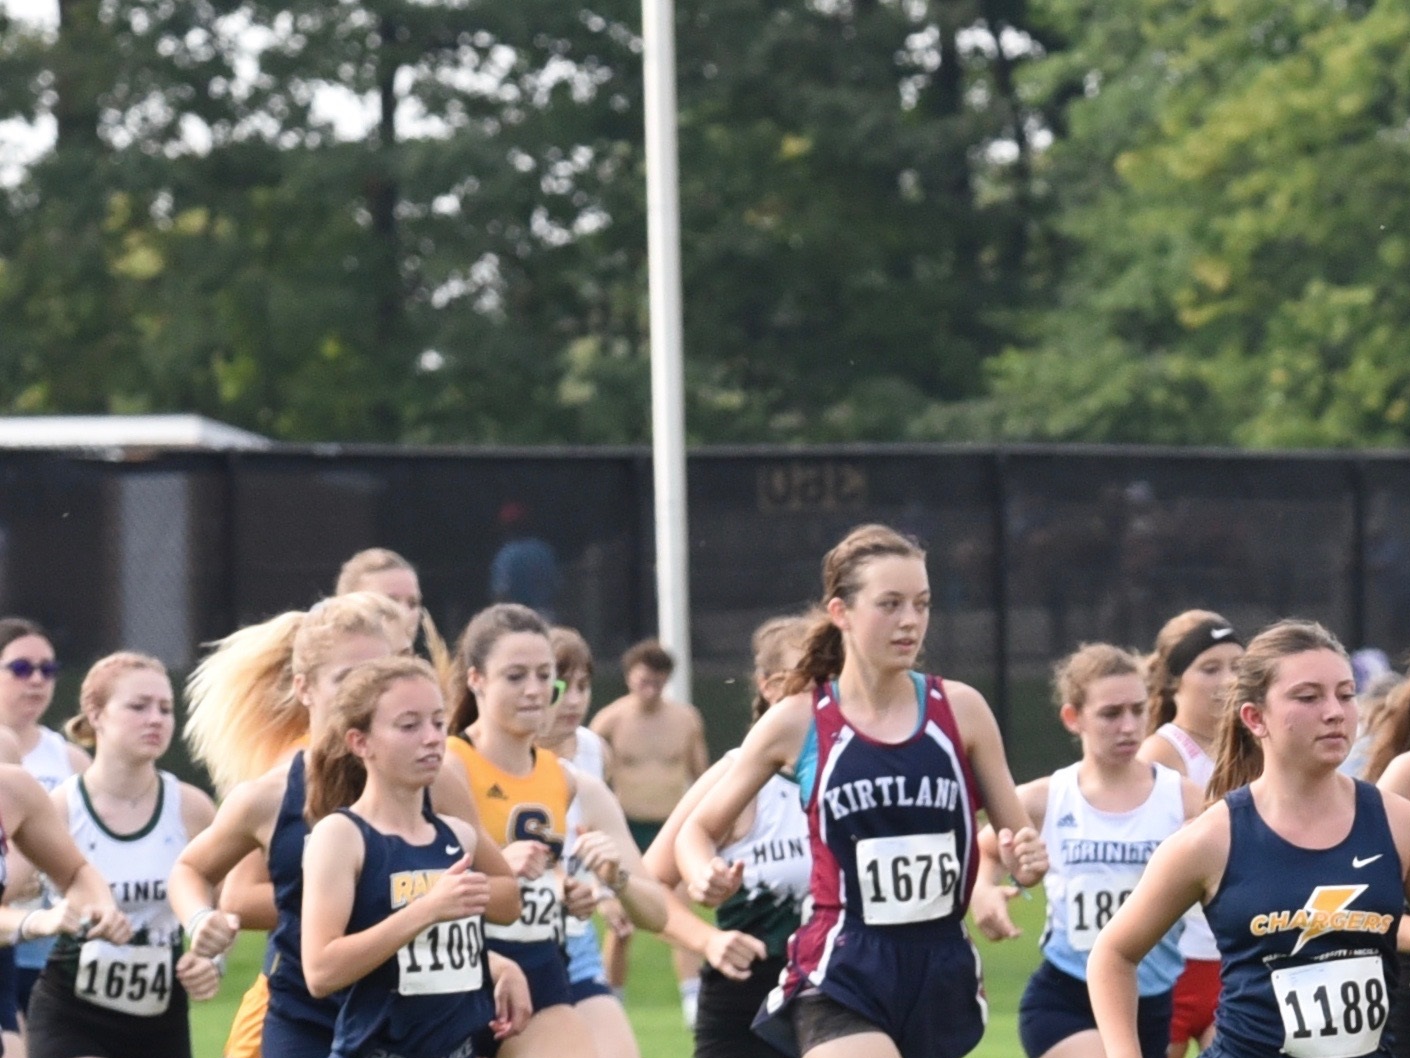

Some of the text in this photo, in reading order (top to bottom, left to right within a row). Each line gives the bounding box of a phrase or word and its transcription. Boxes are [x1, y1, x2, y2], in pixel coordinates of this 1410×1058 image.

[753, 838, 810, 864] HUN
[866, 853, 957, 903] 1676
[1250, 910, 1394, 937] CHARGERS
[82, 959, 168, 1002] 1654
[1284, 978, 1386, 1039] 1188
